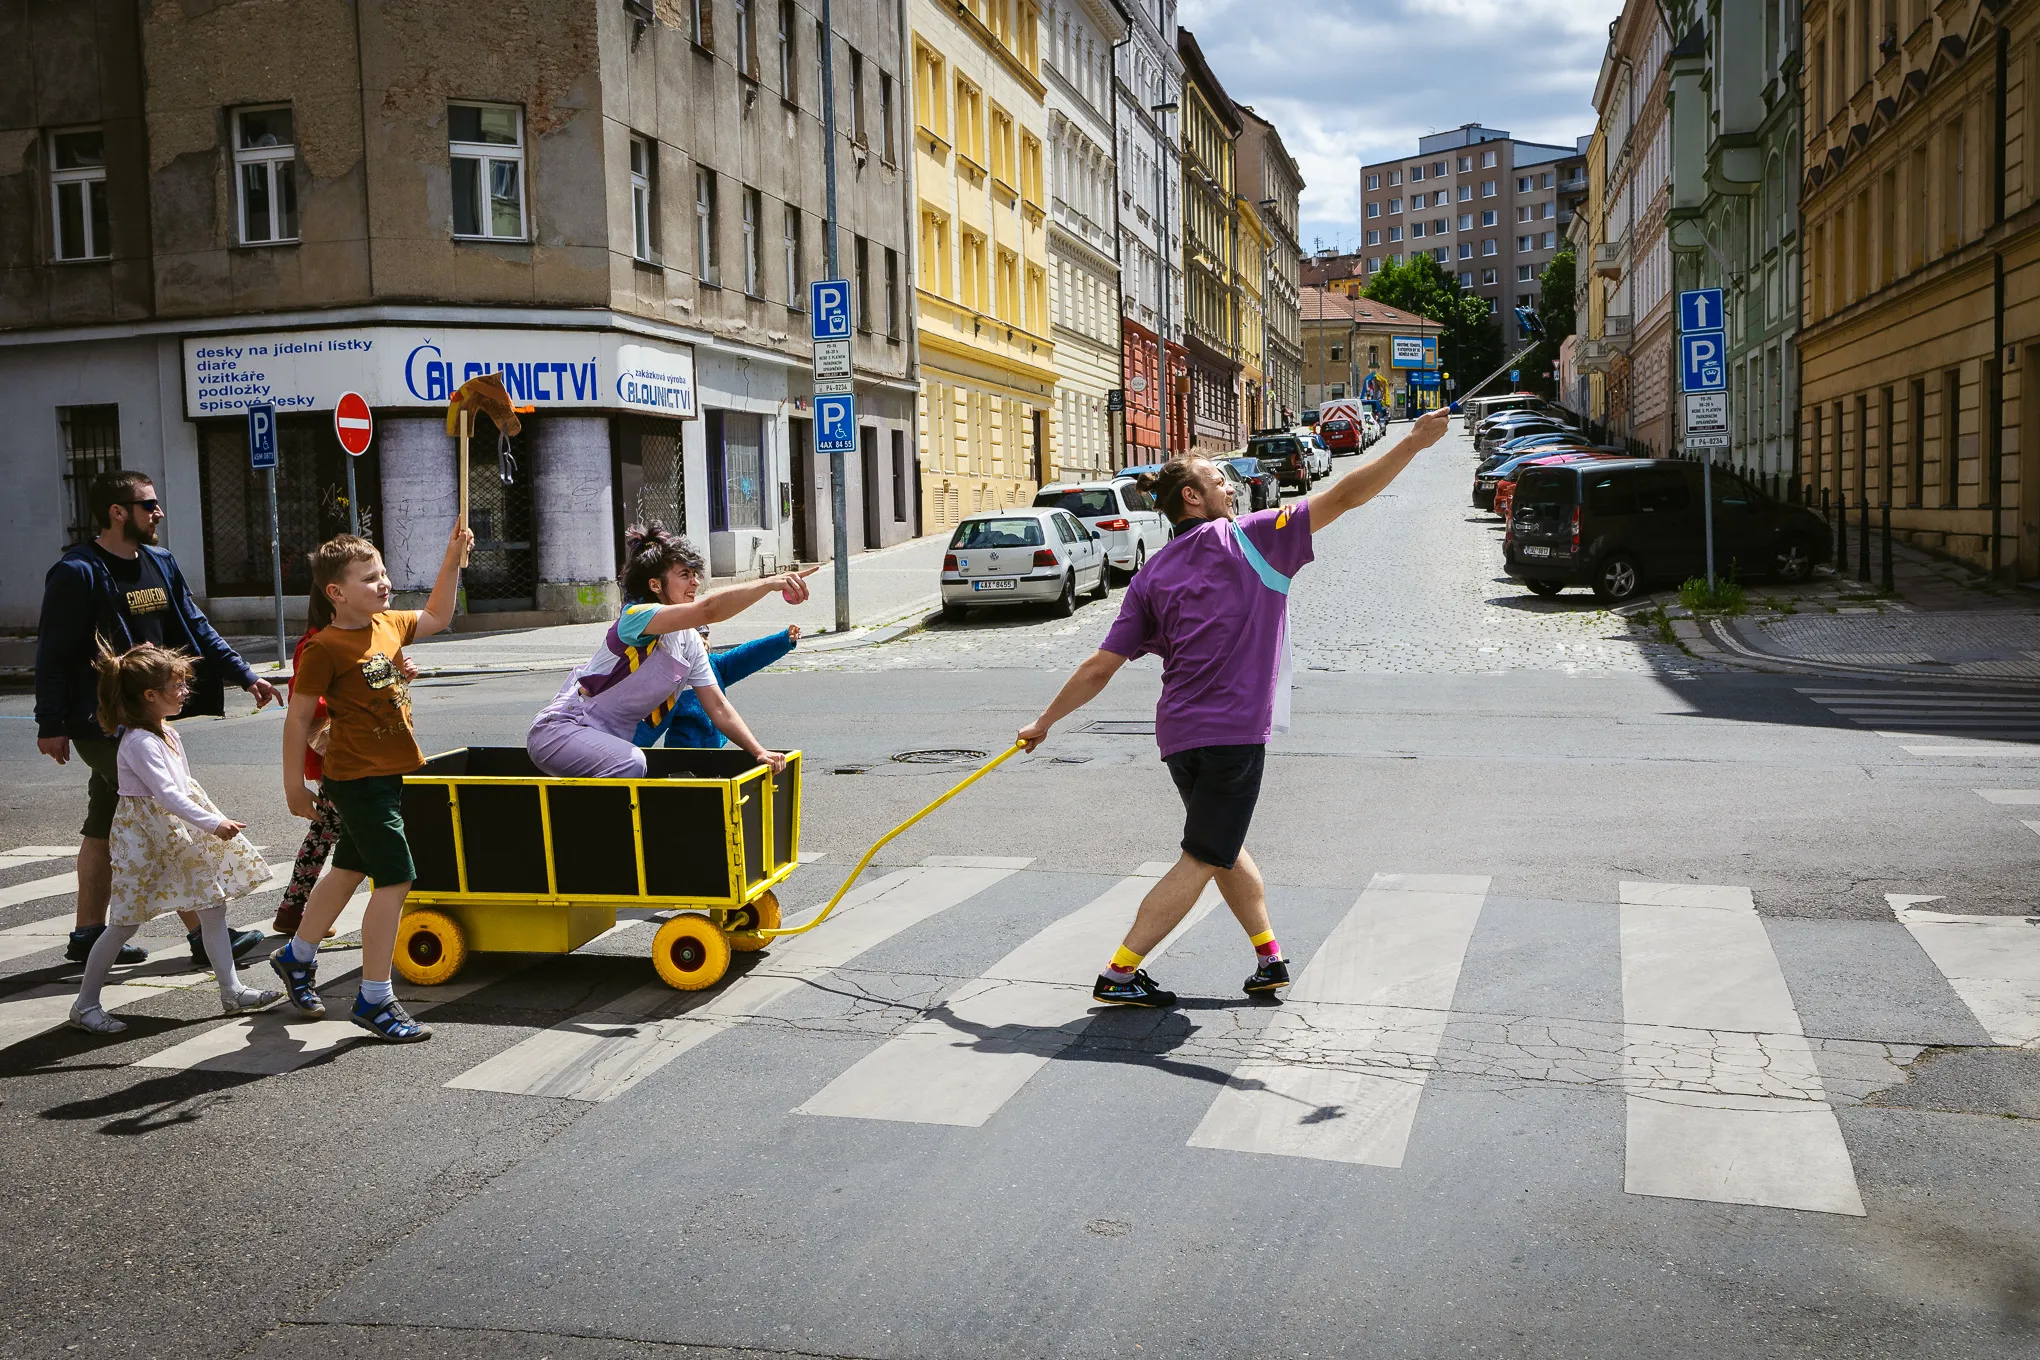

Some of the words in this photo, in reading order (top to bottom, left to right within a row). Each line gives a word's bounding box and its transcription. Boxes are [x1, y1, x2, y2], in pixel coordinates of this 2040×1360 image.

[820, 289, 840, 320] P
[197, 347, 243, 360] desky
[249, 345, 267, 356] na
[273, 341, 322, 357] jídelní
[328, 339, 373, 351] lístky
[1691, 340, 1715, 373] P
[197, 359, 236, 372] diaře
[198, 371, 265, 384] vizitkáře
[635, 369, 666, 381] zakázková
[666, 374, 687, 384] výroba
[198, 384, 270, 399] podložky
[268, 395, 315, 408] desky
[823, 402, 845, 435] P
[253, 412, 269, 448] P
[820, 441, 833, 449] 4AX
[835, 440, 843, 448] 84
[844, 440, 852, 448] 55
[980, 581, 992, 589] 4AX
[996, 580, 1012, 588] 8455
[126, 587, 167, 606] CIRQUEON
